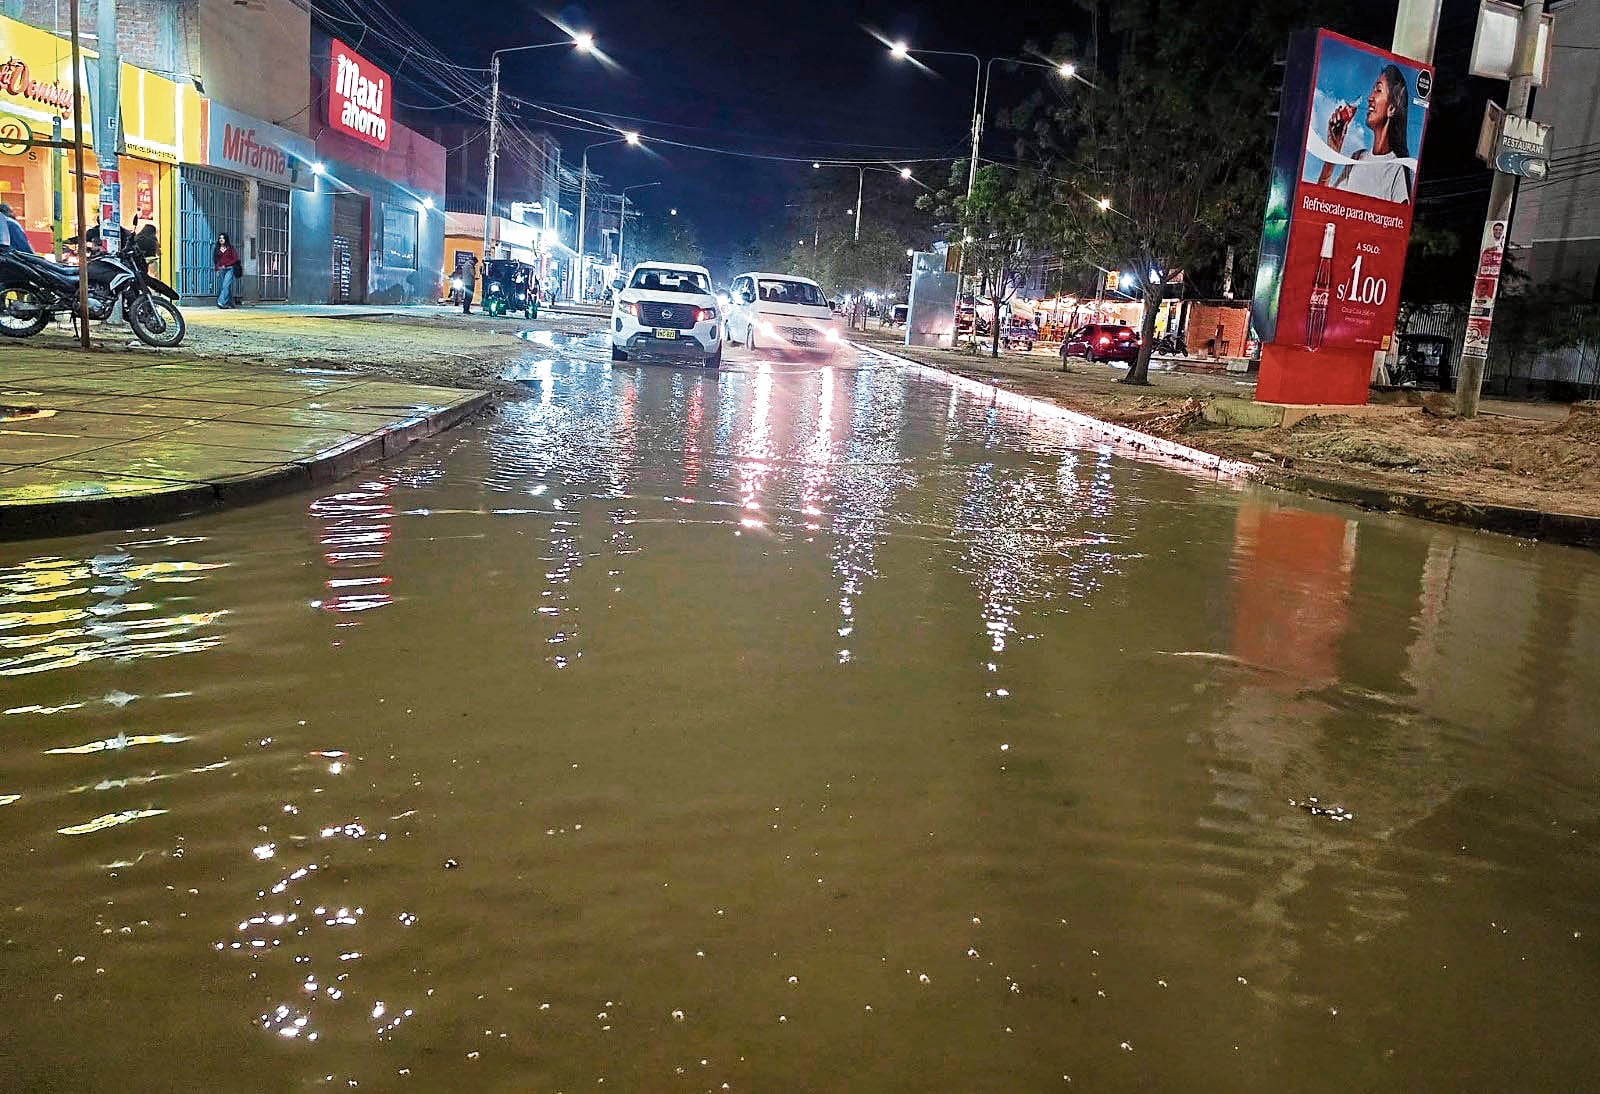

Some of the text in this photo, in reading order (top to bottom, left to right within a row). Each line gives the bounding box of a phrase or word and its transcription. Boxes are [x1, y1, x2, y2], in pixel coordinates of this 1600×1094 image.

[341, 97, 386, 141] ahorro
[222, 122, 286, 176] Mifarma
[1503, 136, 1544, 154] RESTAURANT
[1345, 207, 1364, 220] para
[1356, 242, 1362, 251] A
